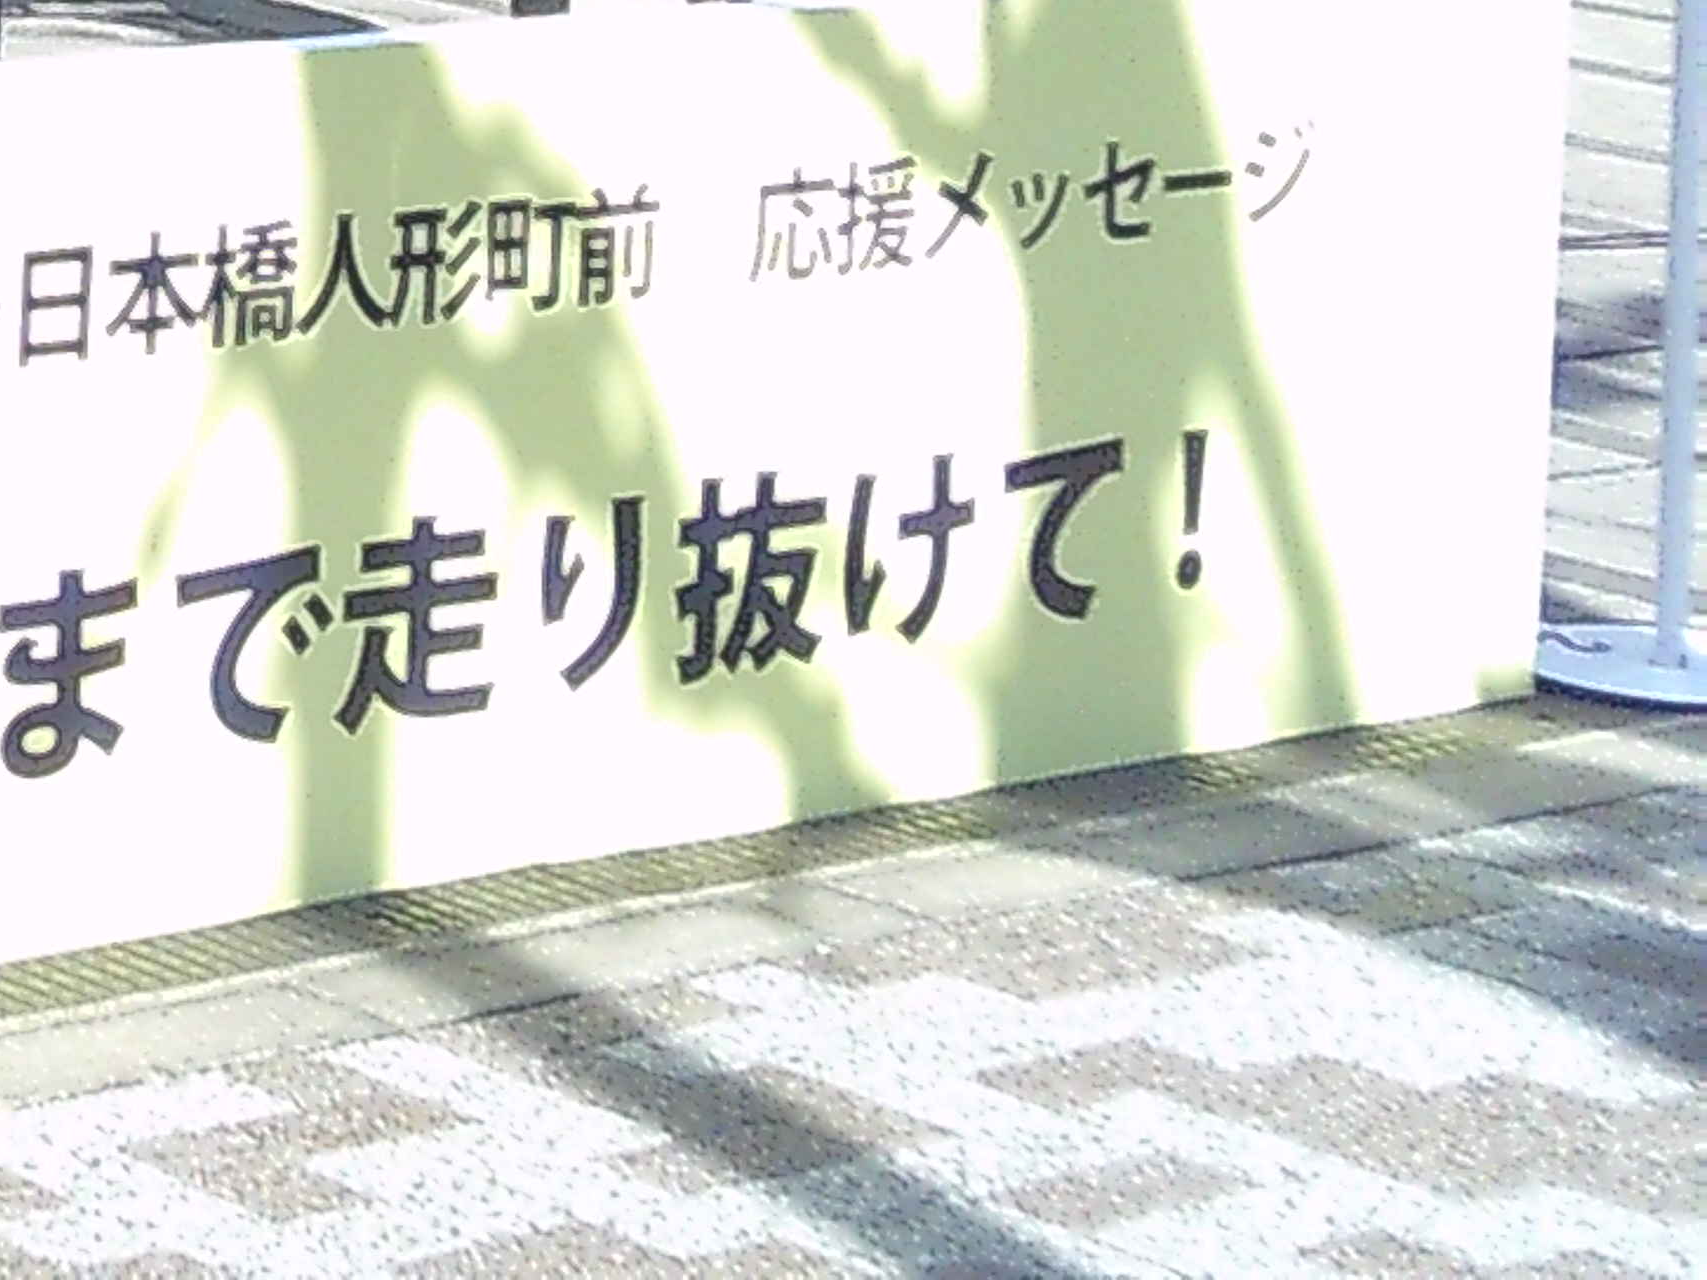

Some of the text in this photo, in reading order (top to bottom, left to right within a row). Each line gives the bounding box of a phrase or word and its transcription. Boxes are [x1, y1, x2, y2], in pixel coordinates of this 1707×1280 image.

[748, 120, 1315, 283] 応援メッセージ
